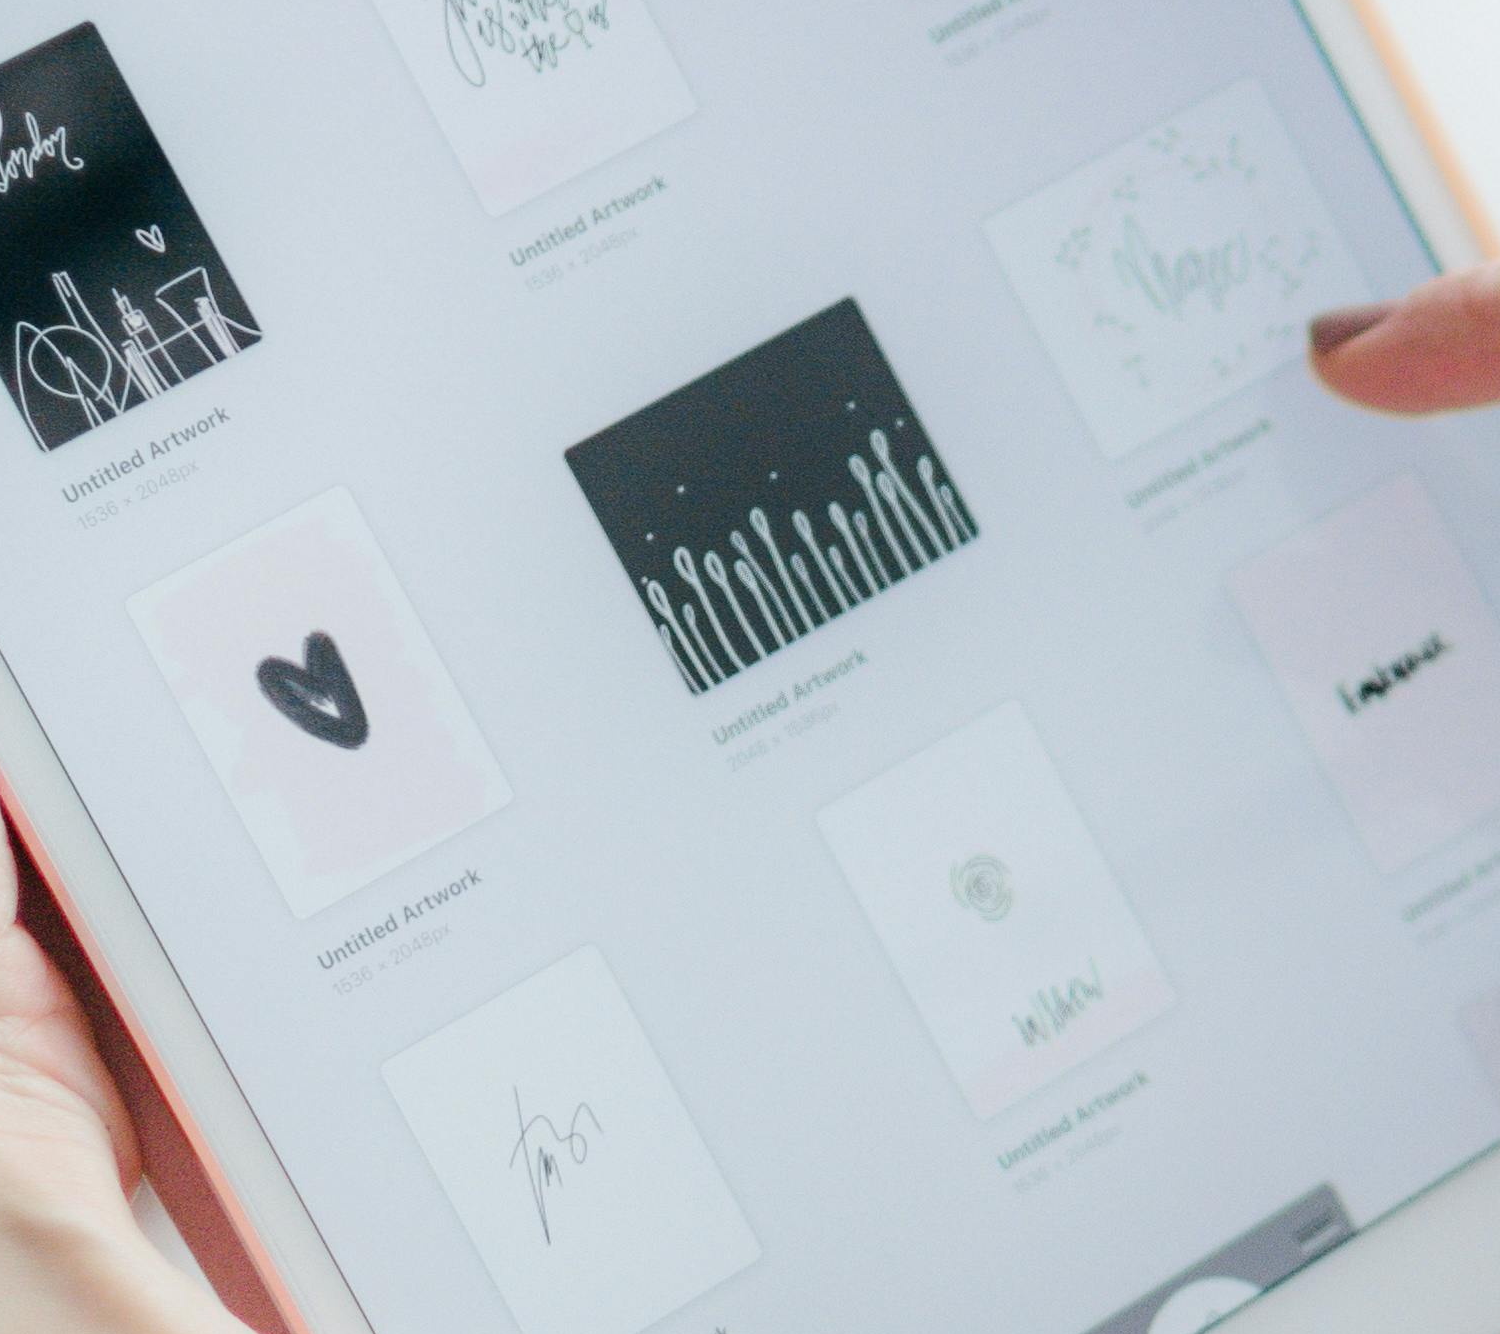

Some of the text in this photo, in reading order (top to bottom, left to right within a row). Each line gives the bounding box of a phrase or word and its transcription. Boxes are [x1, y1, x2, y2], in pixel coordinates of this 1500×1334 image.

[509, 176, 667, 267] Untitled Artwork
[61, 404, 231, 504] Untitled Artwork
[76, 497, 120, 532] 1536
[135, 458, 201, 505] 2048px
[712, 649, 868, 745] Untitled Artwork
[317, 869, 482, 971] Untitled Artwork
[331, 964, 374, 995] 1536
[389, 924, 452, 966] 2048px
